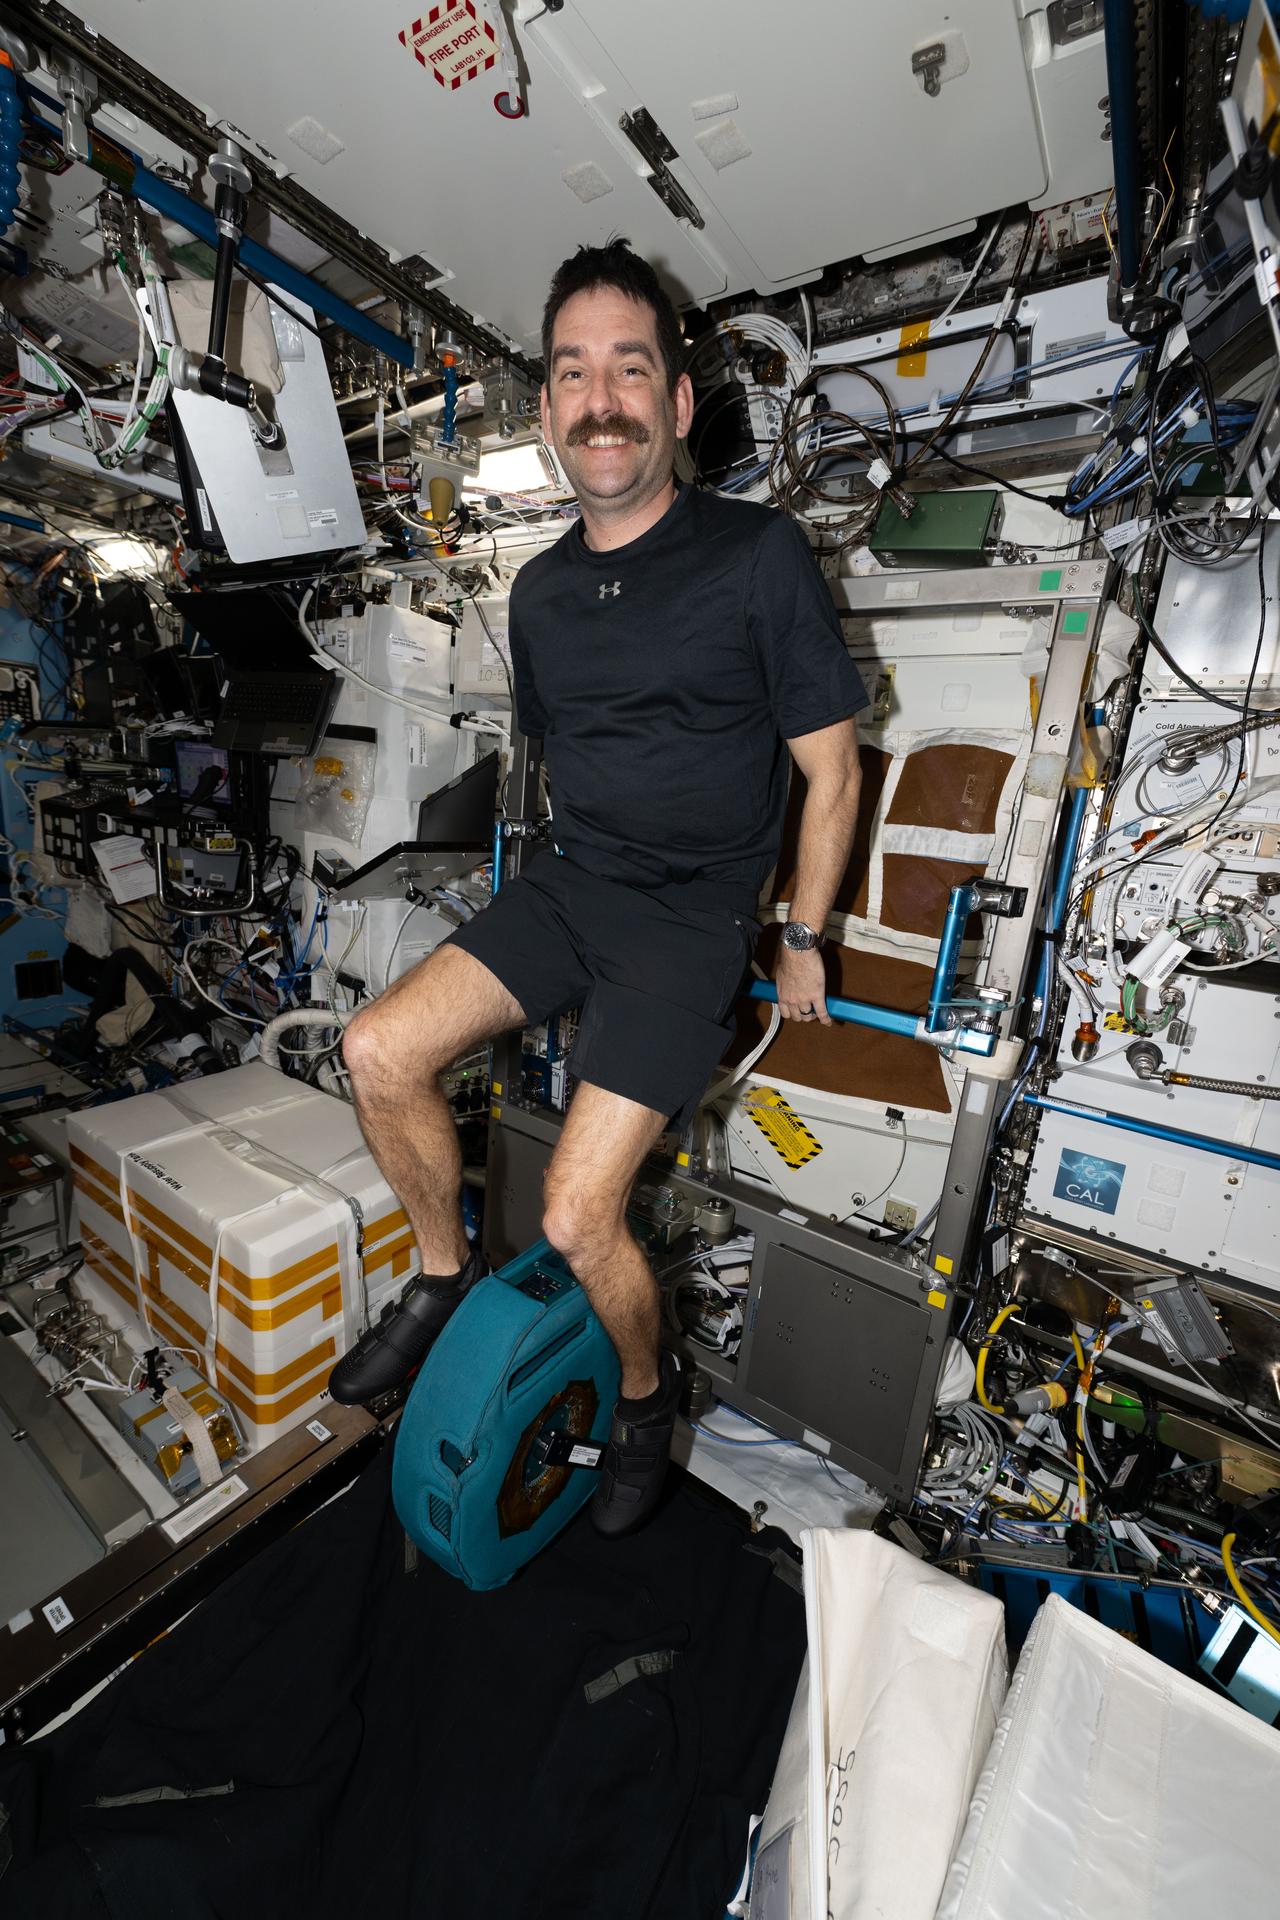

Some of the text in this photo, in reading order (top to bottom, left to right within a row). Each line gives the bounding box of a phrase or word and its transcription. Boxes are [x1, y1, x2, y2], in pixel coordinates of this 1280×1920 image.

[414, 8, 467, 48] EMERGENCY USE
[428, 25, 481, 65] FIRE PORT
[1155, 722, 1176, 730] Cold
[139, 1160, 166, 1179] Resupply
[161, 1176, 183, 1191] Water
[1066, 1184, 1105, 1206] CAL
